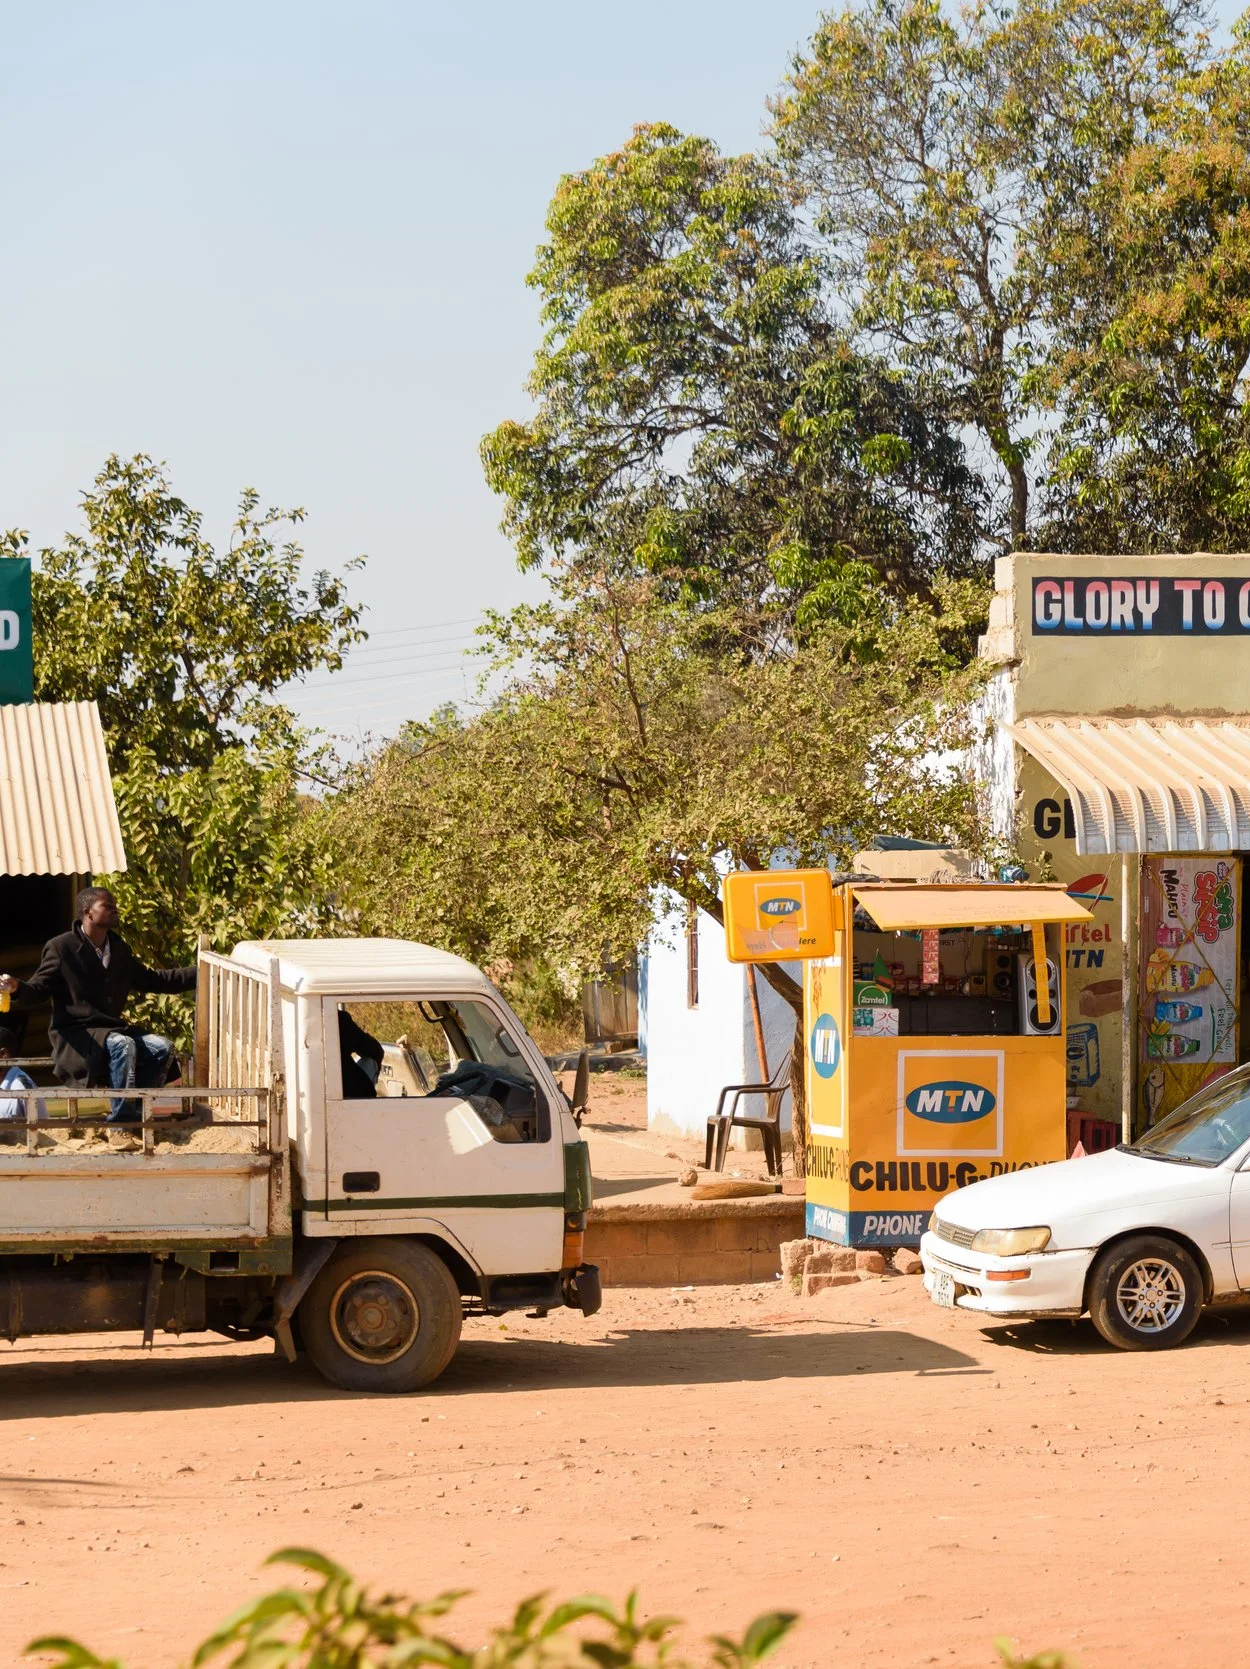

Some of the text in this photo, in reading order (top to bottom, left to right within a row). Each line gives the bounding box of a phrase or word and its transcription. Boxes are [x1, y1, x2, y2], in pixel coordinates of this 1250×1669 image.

[1034, 580, 1160, 630] GLORY
[1174, 580, 1225, 630] TO
[767, 901, 794, 912] MTN
[1066, 923, 1112, 943] irtel
[814, 1029, 836, 1064] MTN
[916, 1090, 985, 1112] MTN
[863, 1214, 923, 1236] PHONE
